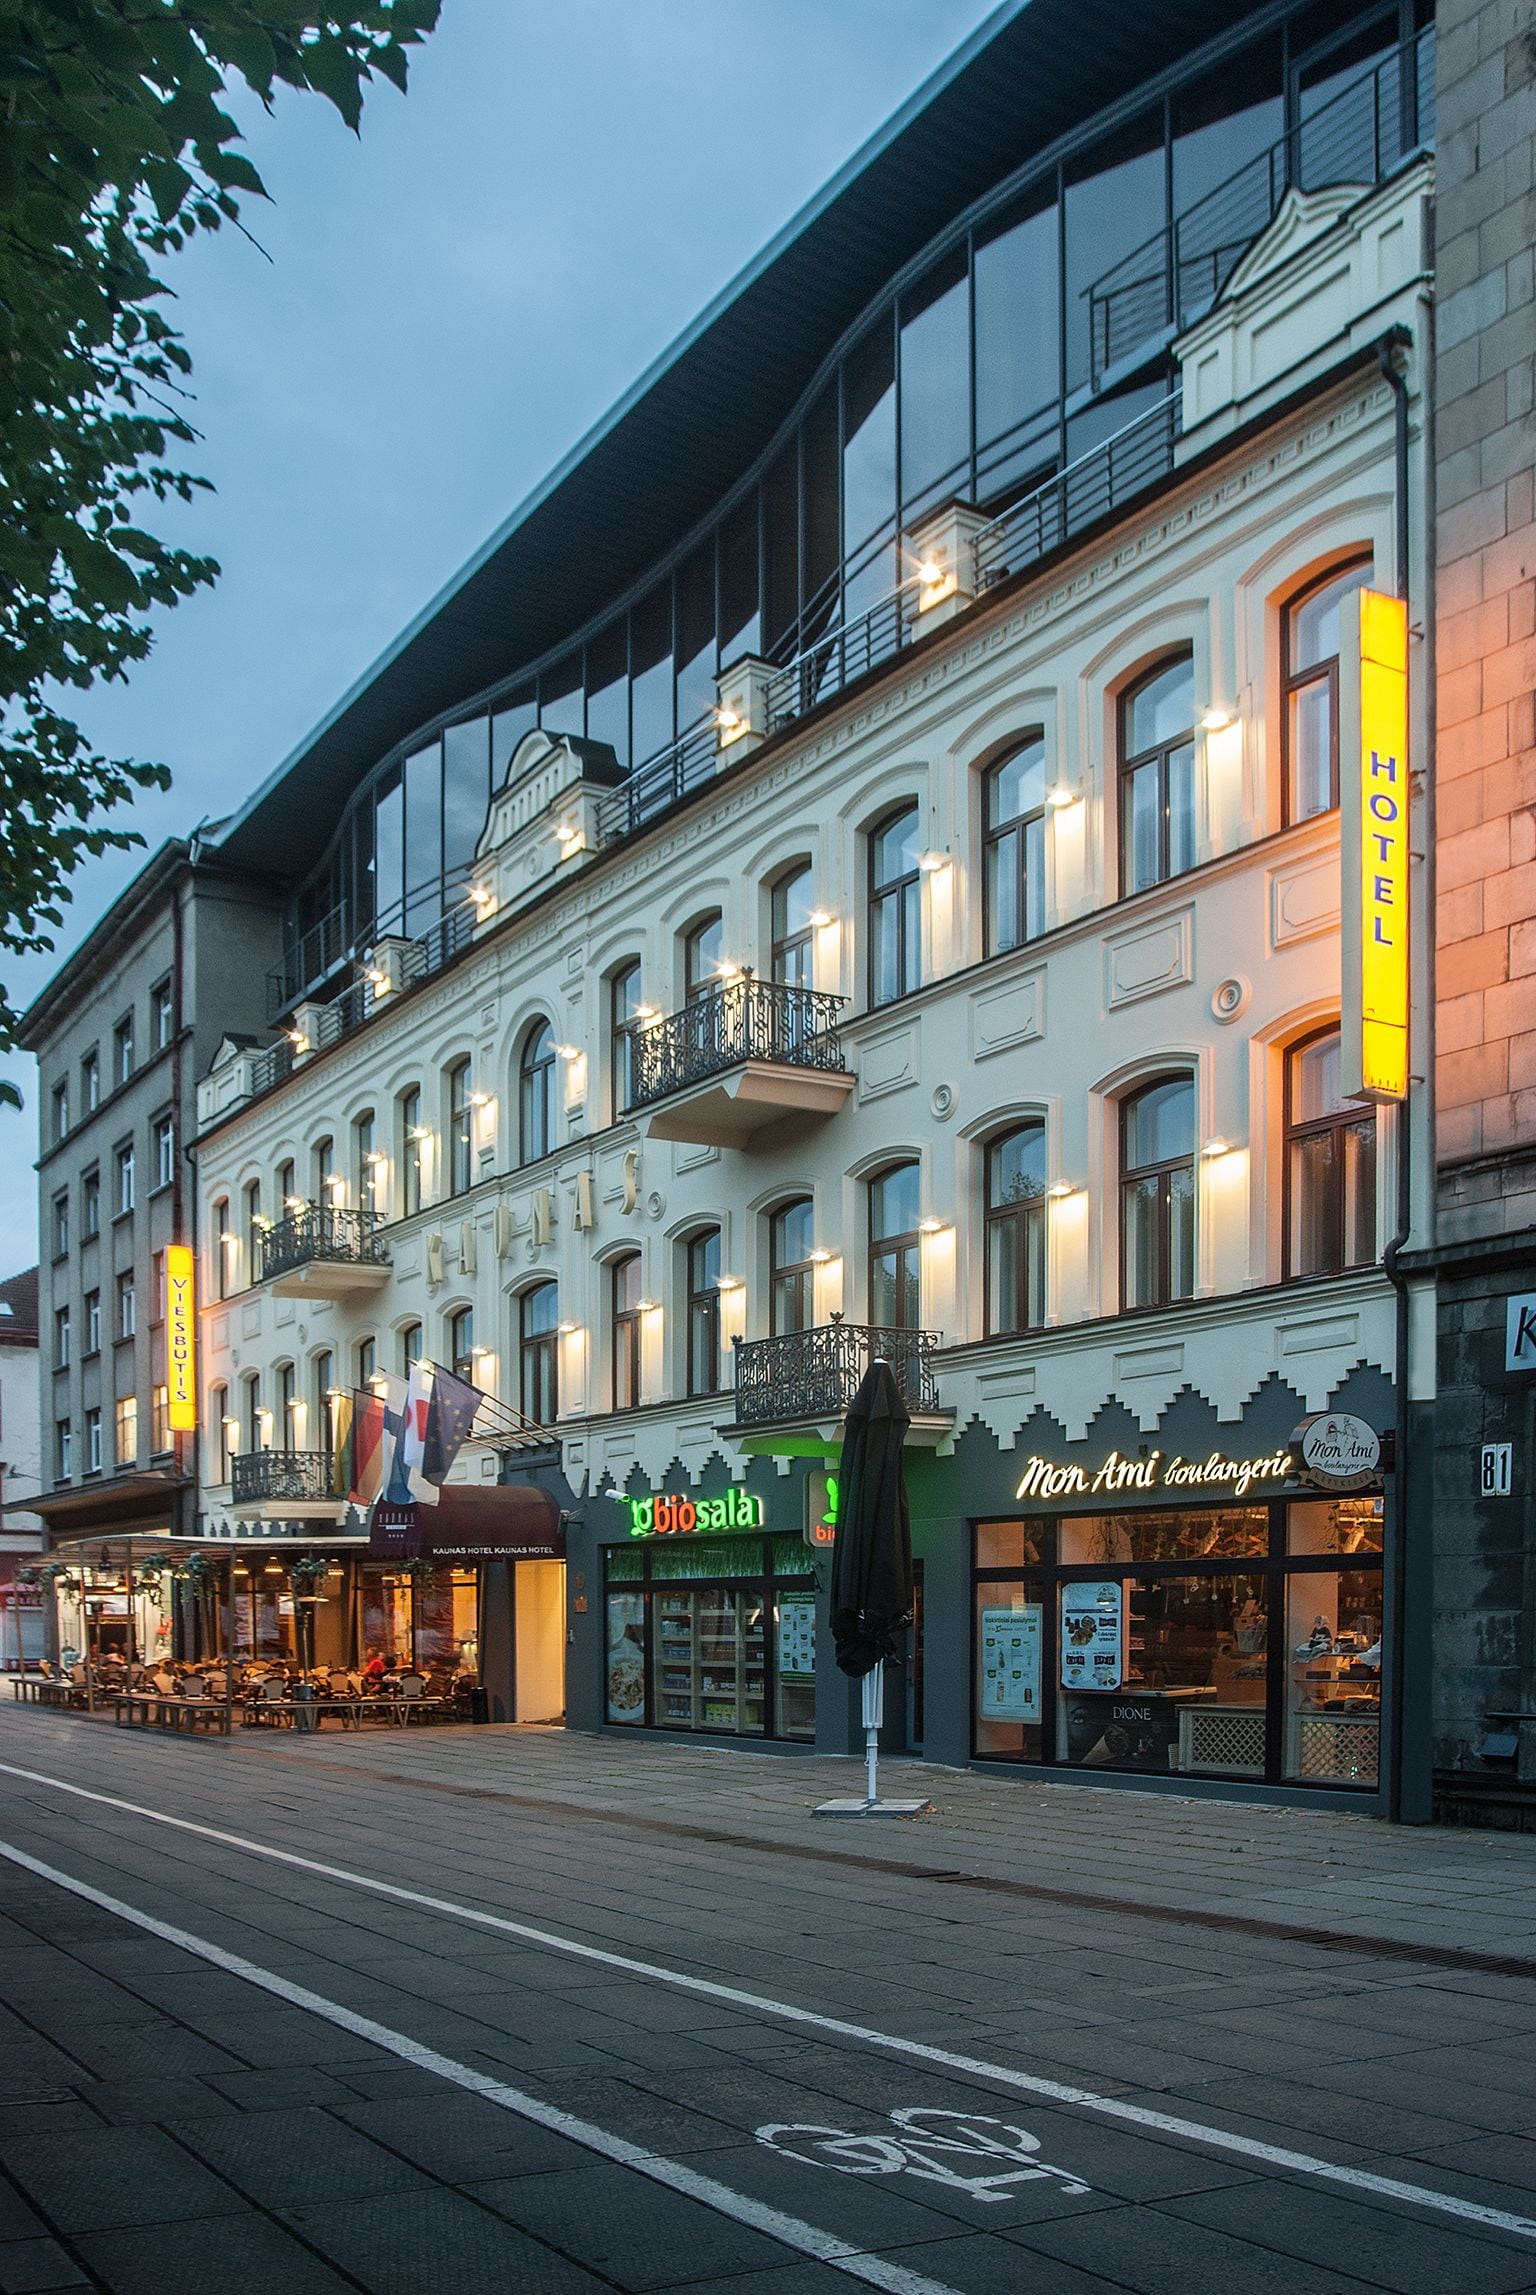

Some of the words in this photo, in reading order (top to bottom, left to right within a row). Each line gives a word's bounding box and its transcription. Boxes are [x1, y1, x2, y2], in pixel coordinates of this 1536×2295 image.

[1369, 751, 1397, 947] HOTEL
[425, 1149, 638, 1284] KAUNAS
[172, 1278, 187, 1402] VIESBUTIS
[1308, 1438, 1342, 1458] Mon
[1345, 1441, 1375, 1458] Ami
[1482, 1450, 1508, 1490] 81
[1016, 1455, 1090, 1499] Mon
[1091, 1451, 1160, 1494] Ami
[1163, 1450, 1292, 1495] boulangerie
[653, 1488, 760, 1534] biosala
[433, 1547, 466, 1555] KAUNAS
[467, 1546, 493, 1555] HOTEL
[494, 1546, 527, 1555] KAUNAS
[528, 1546, 554, 1554] HOTEL
[1113, 1706, 1151, 1721] DIONE
